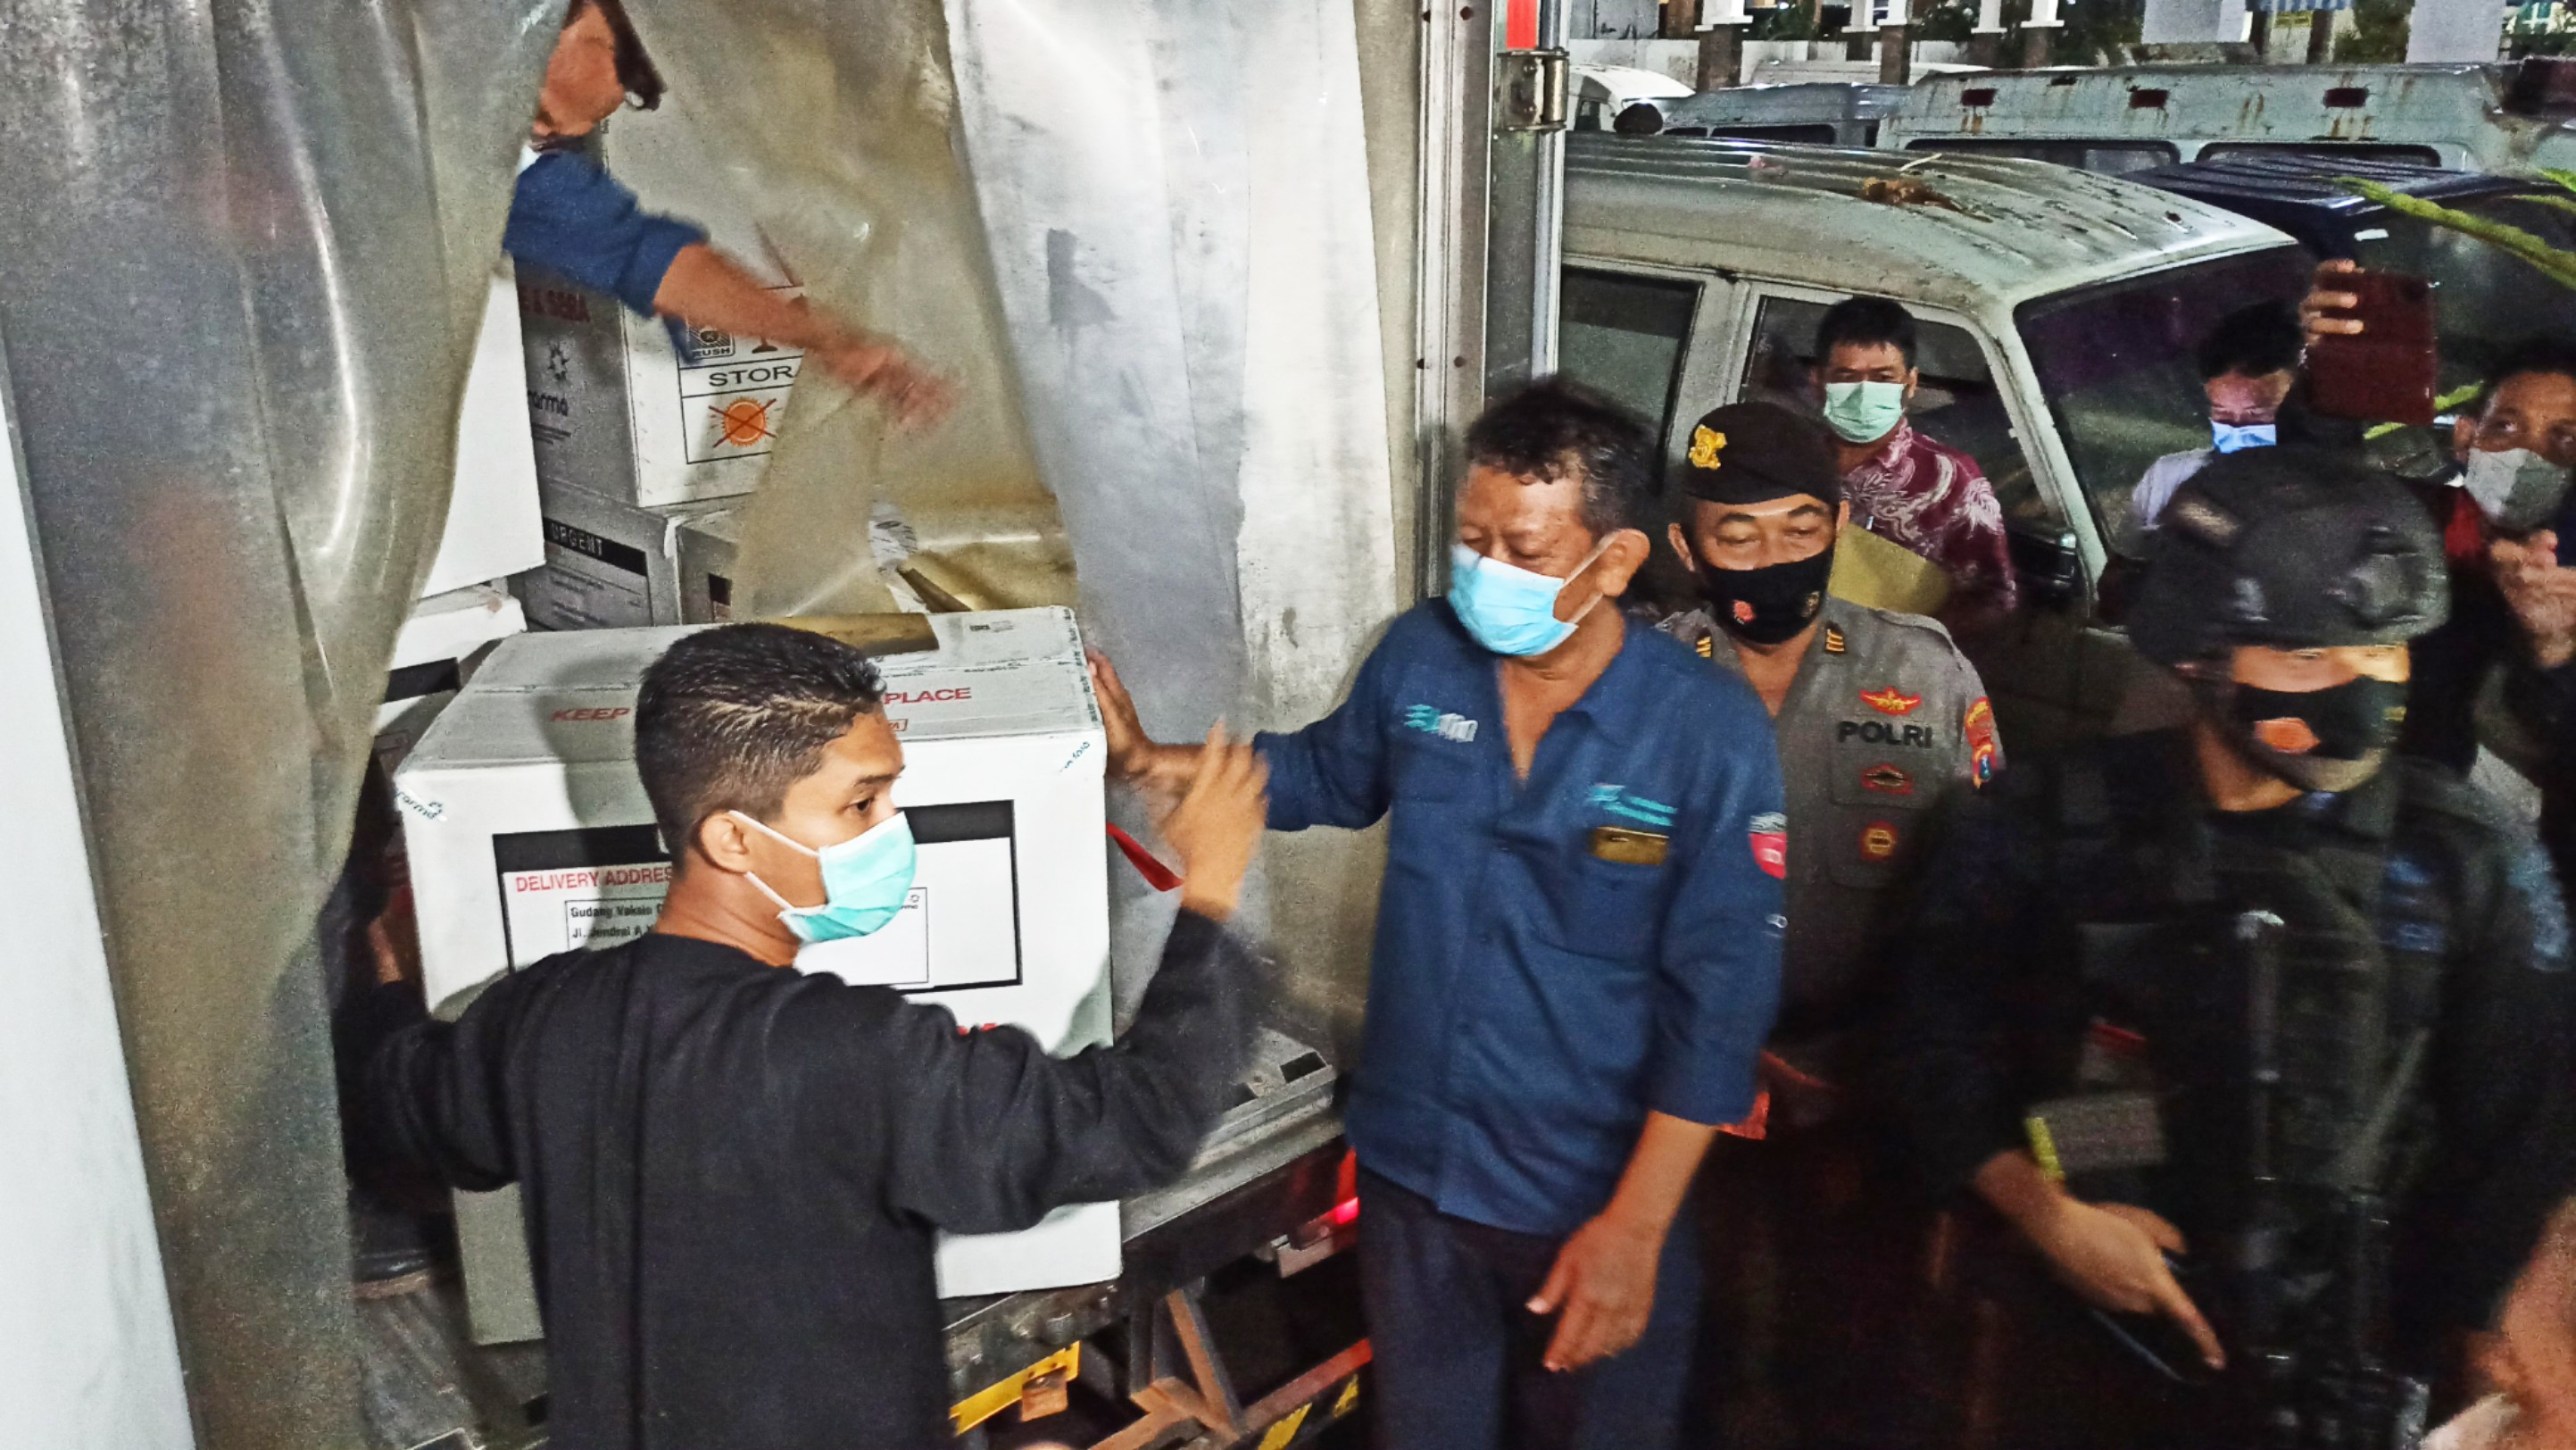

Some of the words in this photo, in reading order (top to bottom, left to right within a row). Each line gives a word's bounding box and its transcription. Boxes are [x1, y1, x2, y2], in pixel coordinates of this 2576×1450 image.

[709, 365, 797, 387] STOR
[551, 522, 602, 556] URGENT
[551, 706, 630, 722] KEEP
[883, 687, 972, 704] PLACE
[1837, 721, 1932, 749] POLRI
[515, 871, 599, 892] DELIVERY
[570, 906, 613, 920] Gudang
